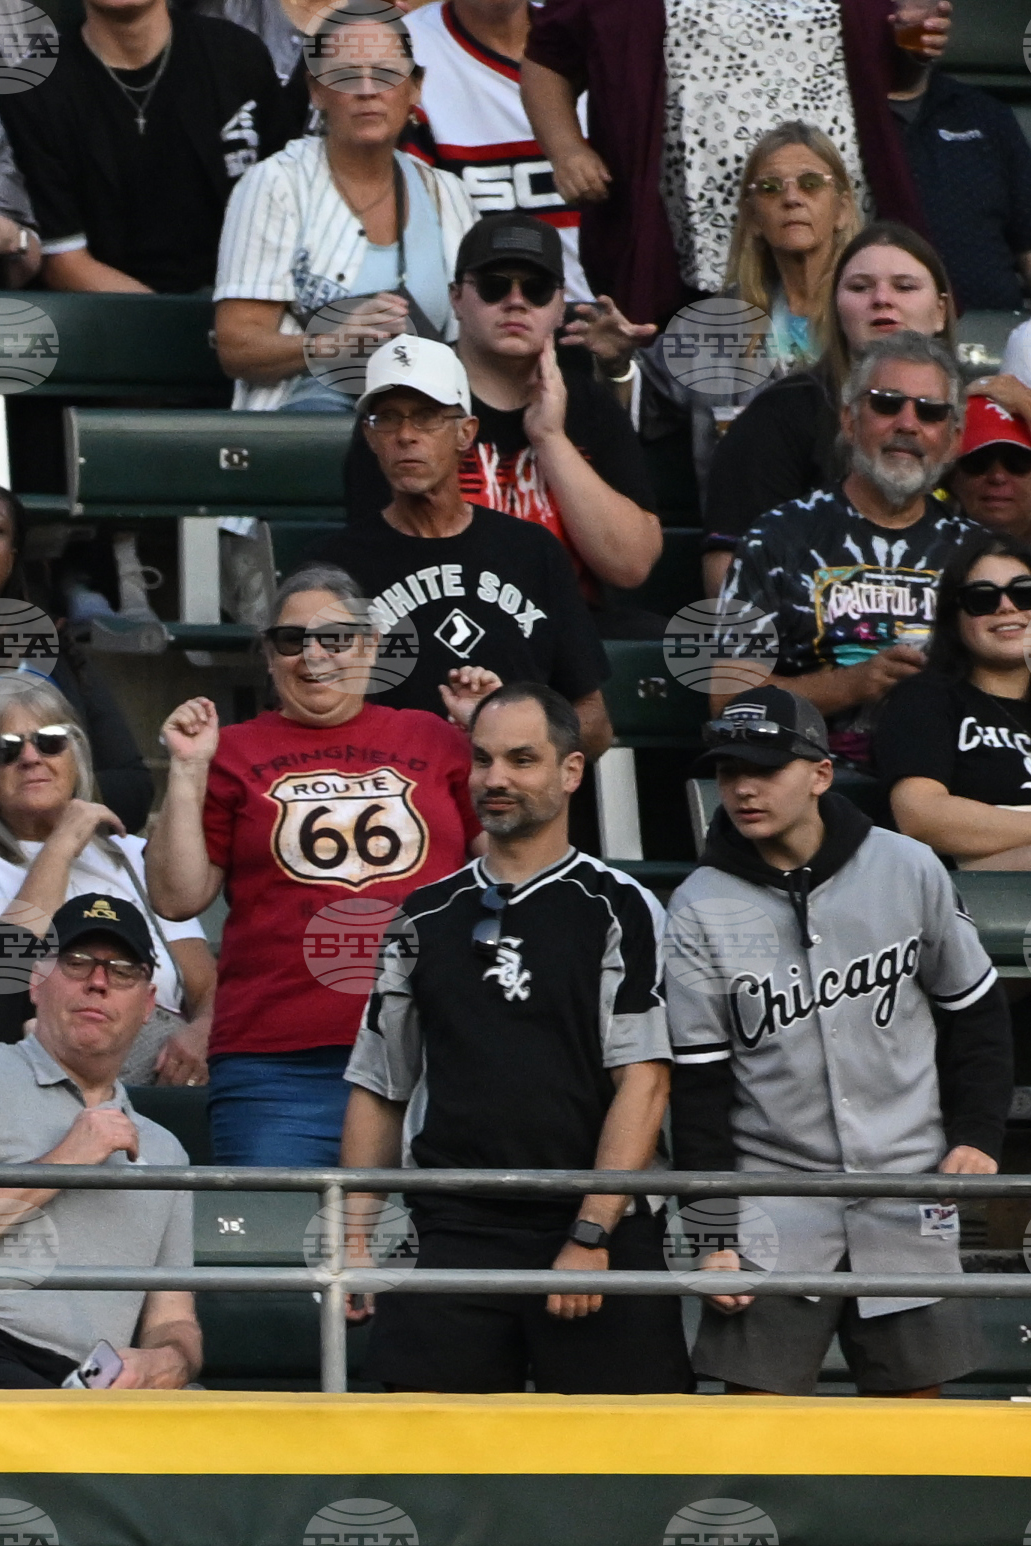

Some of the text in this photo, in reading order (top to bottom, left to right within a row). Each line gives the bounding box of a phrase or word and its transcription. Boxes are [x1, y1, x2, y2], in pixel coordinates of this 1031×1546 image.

[367, 564, 548, 640] WHITE SOX
[293, 776, 390, 796] ROUTE
[299, 803, 402, 870] 66
[729, 935, 921, 1050] Chicago
